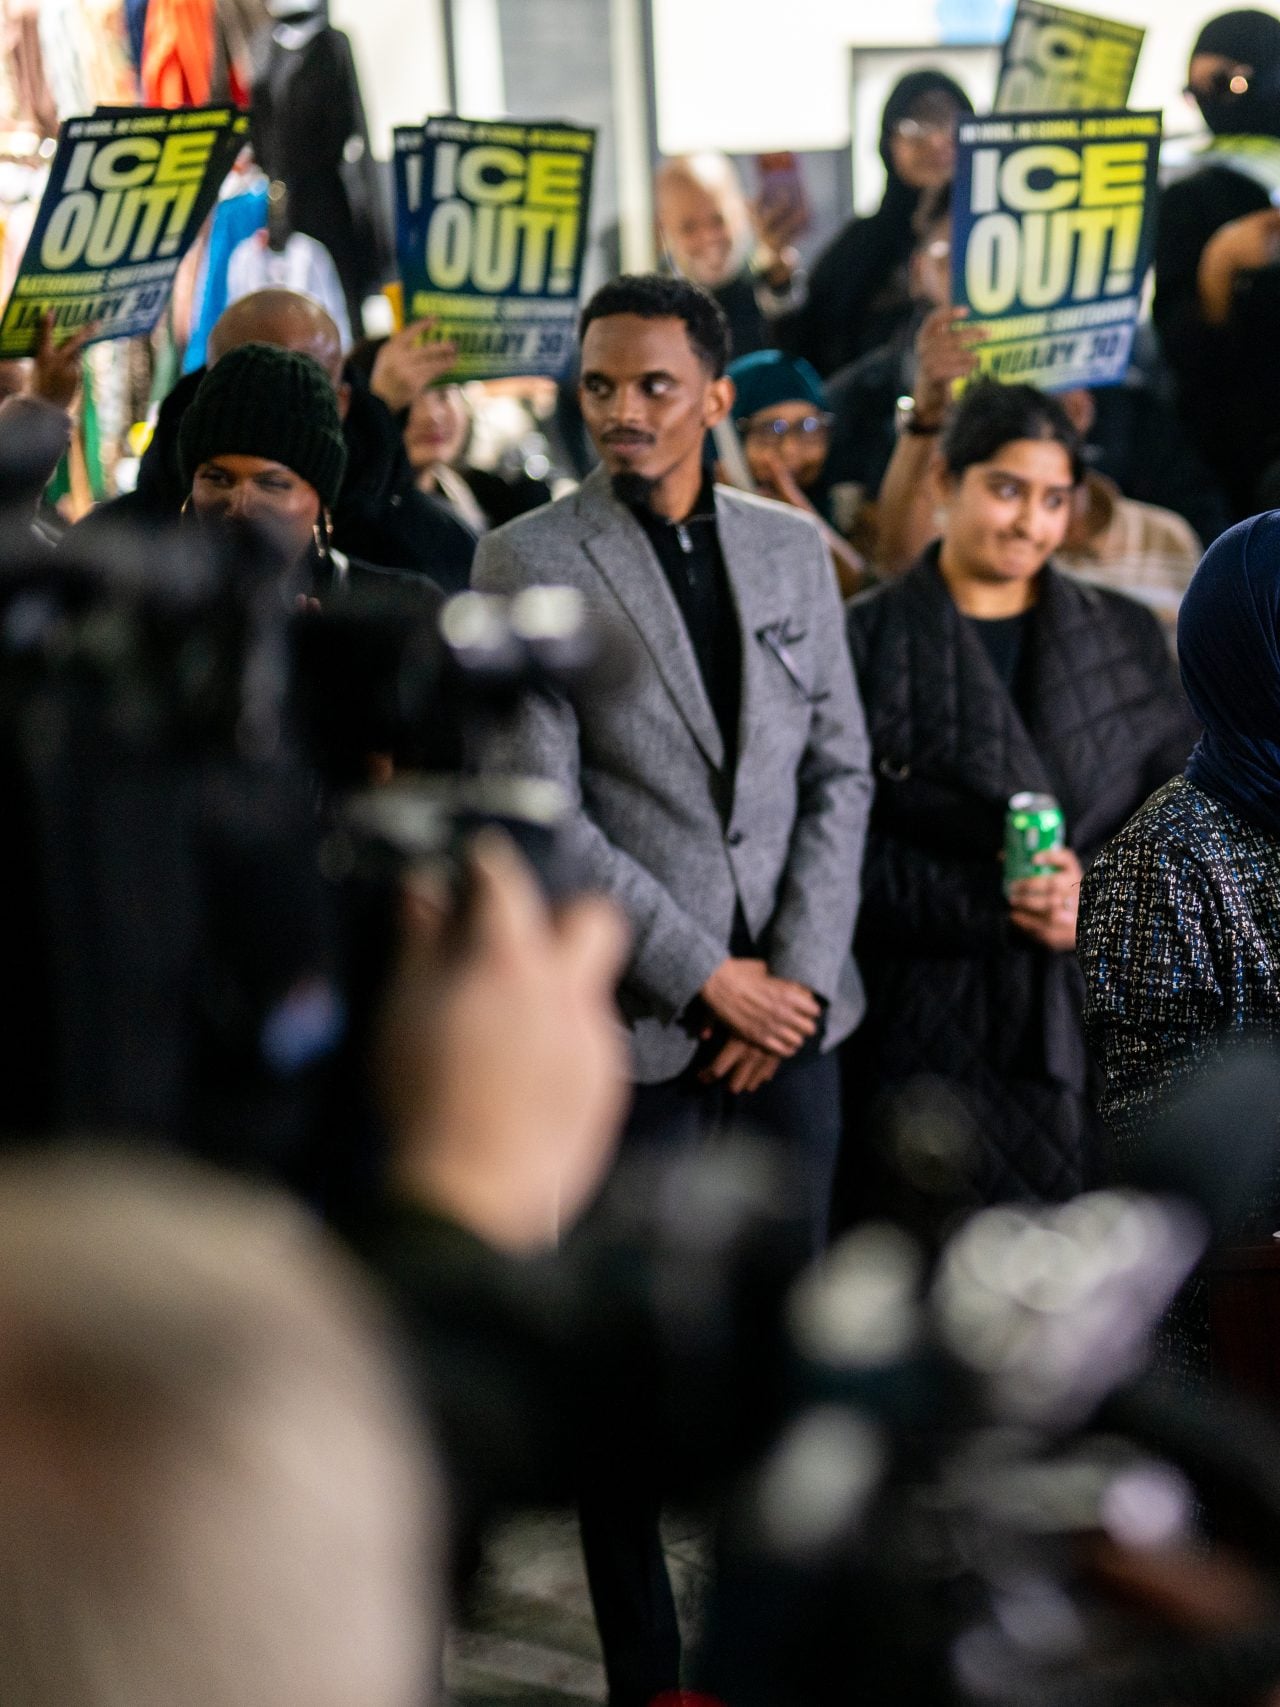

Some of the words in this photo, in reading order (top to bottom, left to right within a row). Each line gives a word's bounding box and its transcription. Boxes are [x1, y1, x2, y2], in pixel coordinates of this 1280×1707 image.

[61, 131, 218, 192] ICE
[432, 141, 584, 206] ICE
[970, 142, 1148, 214] ICE
[40, 183, 202, 270] OUT!
[425, 199, 578, 293] OUT!
[965, 206, 1144, 315] OUT!
